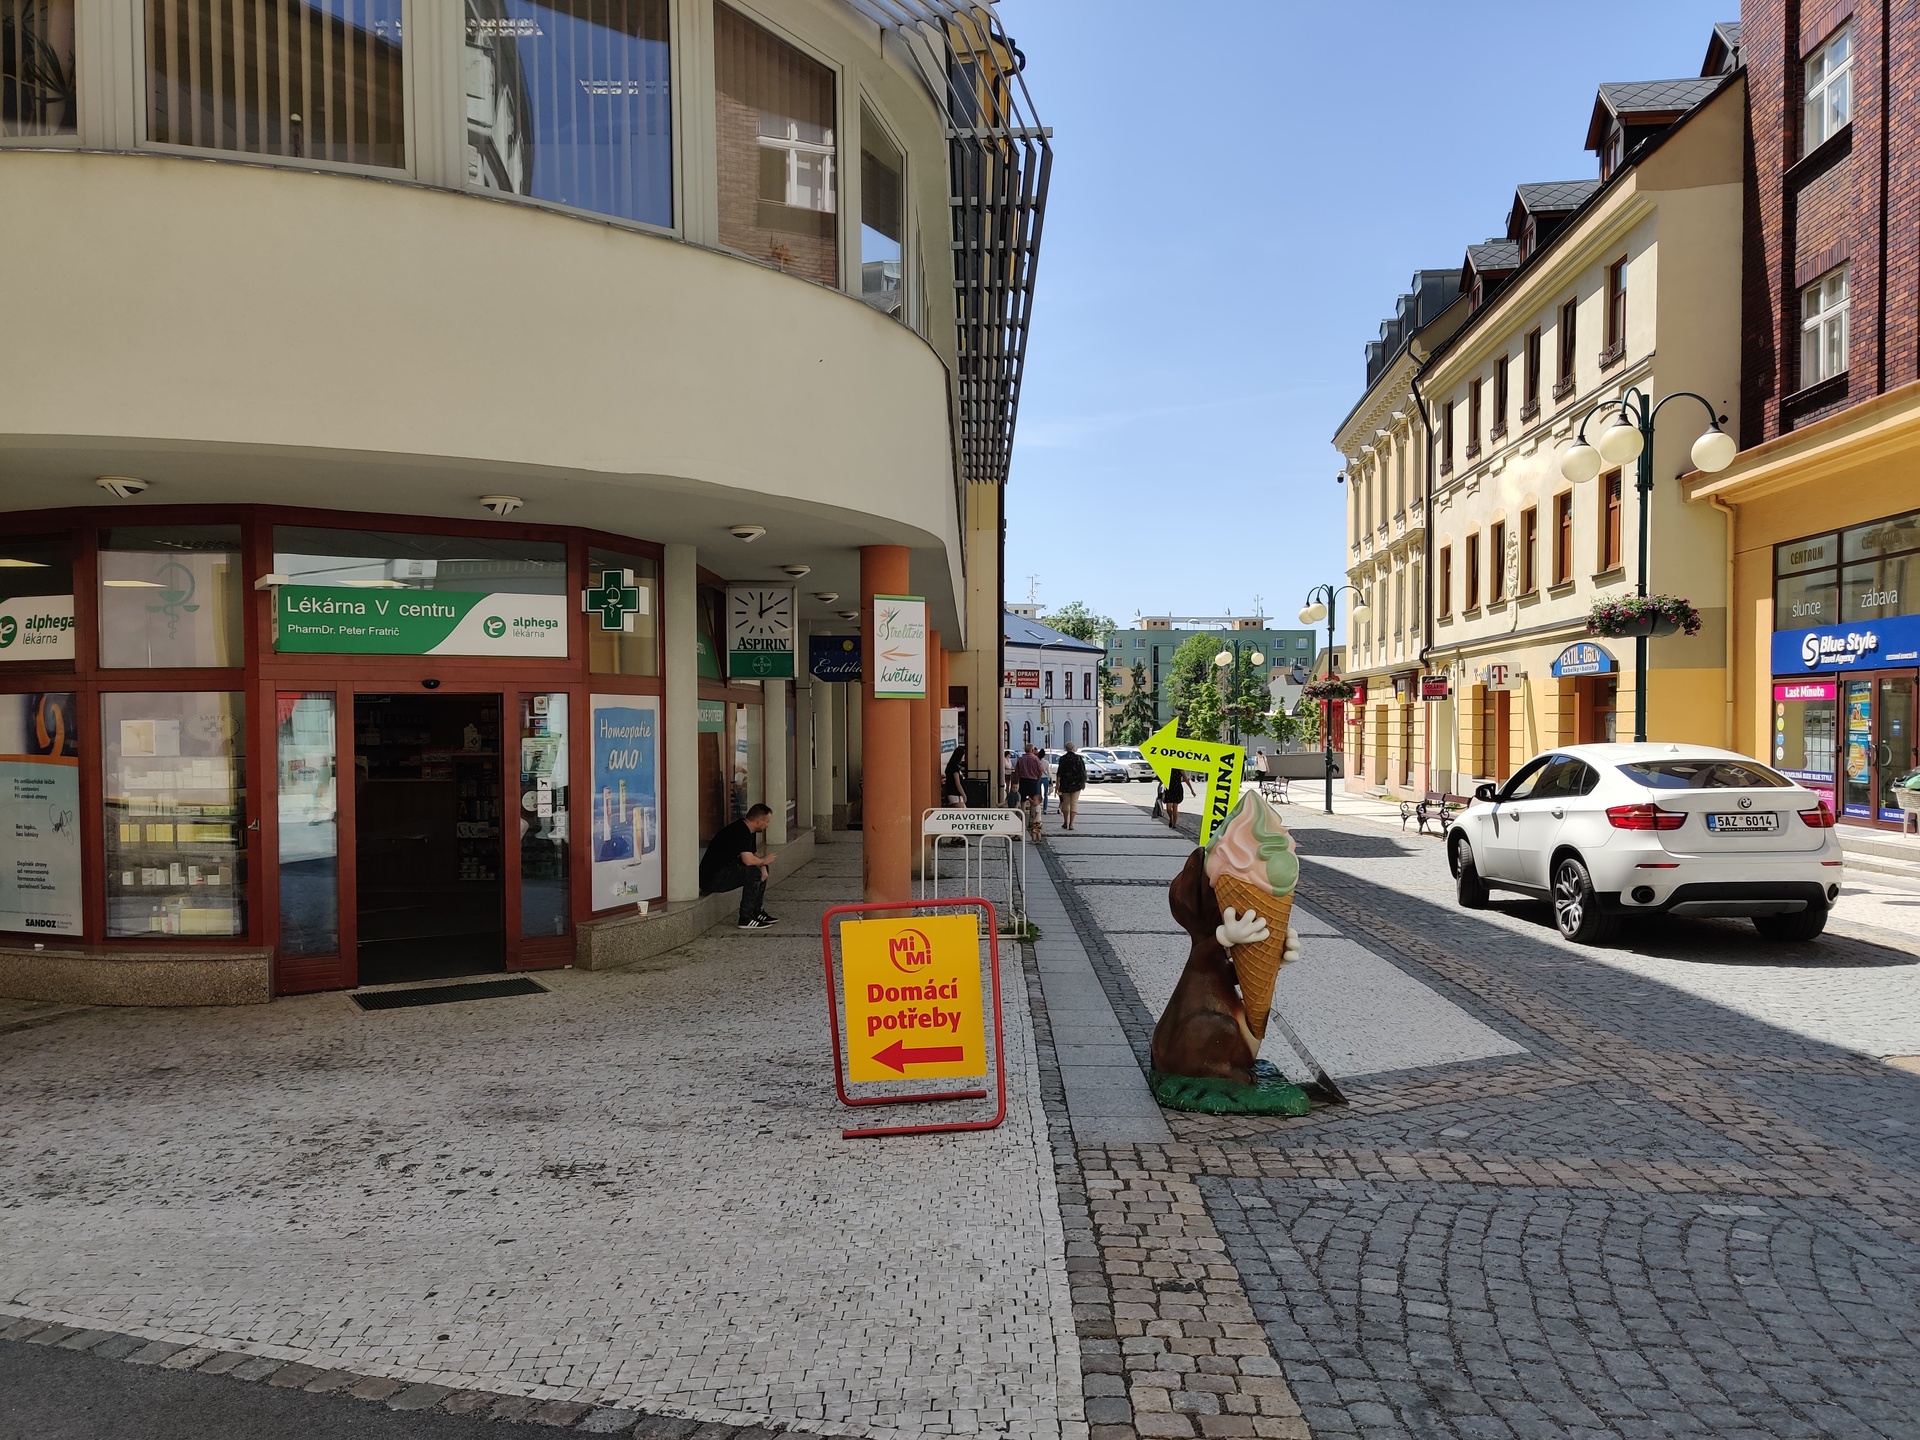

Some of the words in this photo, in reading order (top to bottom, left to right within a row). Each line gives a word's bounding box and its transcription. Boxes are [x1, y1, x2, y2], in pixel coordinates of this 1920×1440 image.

[1790, 546, 1823, 565] CENTRUM
[1861, 588, 1898, 608] zábava
[287, 597, 365, 615] Lékárna
[375, 600, 389, 615] V
[399, 603, 455, 617] centru
[1792, 600, 1821, 617] slunce
[25, 614, 74, 632] alphega
[288, 625, 336, 635] PharmDr.
[339, 626, 366, 635] Peter
[369, 626, 400, 636] Fratrič
[513, 617, 558, 629] alphega
[22, 633, 58, 644] lékárna
[513, 629, 545, 638] lékárna
[737, 637, 787, 652] ASPIRIN
[1820, 636, 1845, 653] Blue
[1847, 631, 1877, 655] Style
[1560, 646, 1580, 666] TEXTIL
[1583, 646, 1601, 663] OBUV
[1820, 655, 1835, 664] Travel
[1835, 654, 1856, 664] Agency
[881, 666, 923, 687] květiny
[1492, 665, 1508, 685] T
[1785, 687, 1799, 698] Last
[1800, 686, 1825, 697] Minute
[600, 718, 651, 745] Homeopatie
[608, 749, 643, 771] ano!
[1150, 747, 1157, 755] Z
[1160, 748, 1211, 763] OPOČNA
[1210, 753, 1235, 838] RZLINA
[936, 812, 1010, 821] ZDRAVOTNICKÉ
[1717, 816, 1738, 827] 5AZ
[1745, 815, 1772, 826] 6014
[951, 821, 995, 830] POTŘEBY
[25, 919, 57, 928] SANDOZ
[889, 935, 915, 951] Mi
[906, 950, 932, 965] Mi
[867, 978, 958, 1003] Domácí
[867, 1007, 961, 1037] potřeby
